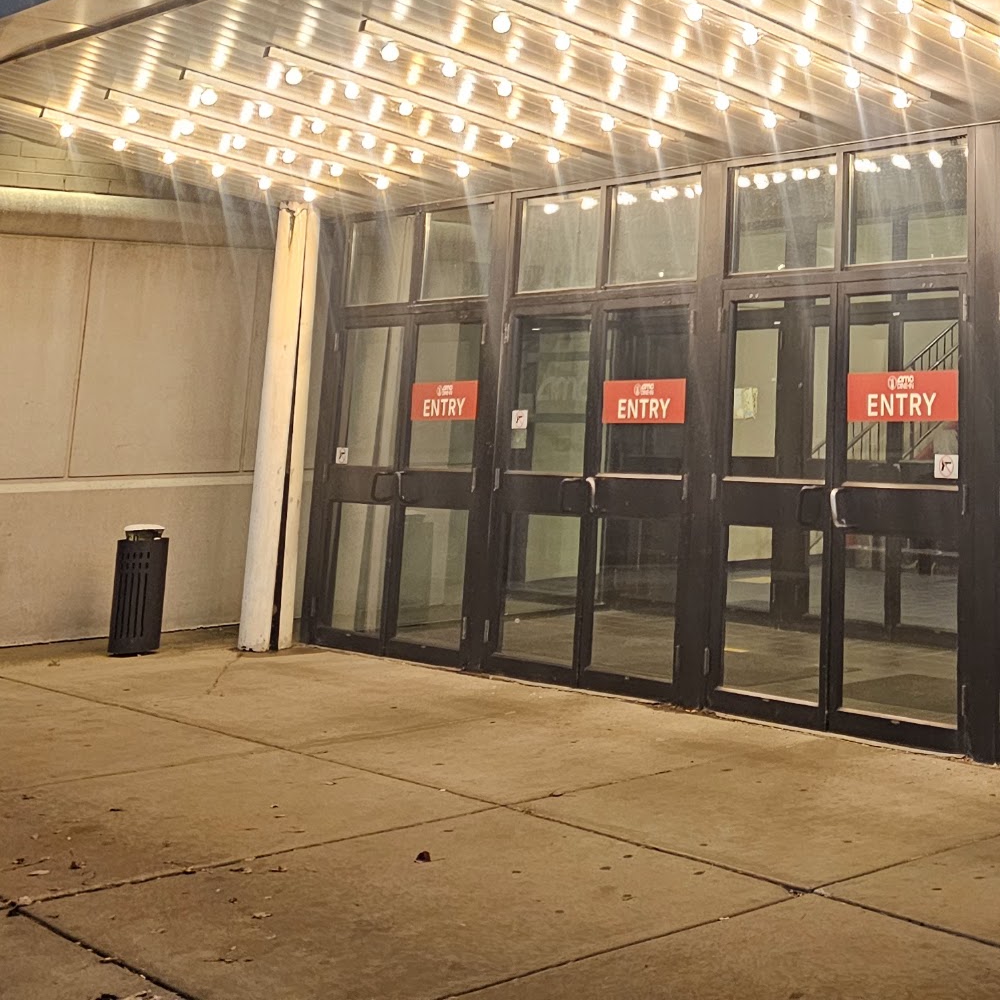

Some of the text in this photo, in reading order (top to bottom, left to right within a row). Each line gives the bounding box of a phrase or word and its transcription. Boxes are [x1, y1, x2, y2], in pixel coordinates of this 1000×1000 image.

[423, 397, 466, 417] ENTRY
[617, 398, 671, 419] ENTRY
[867, 392, 937, 417] ENTRY
